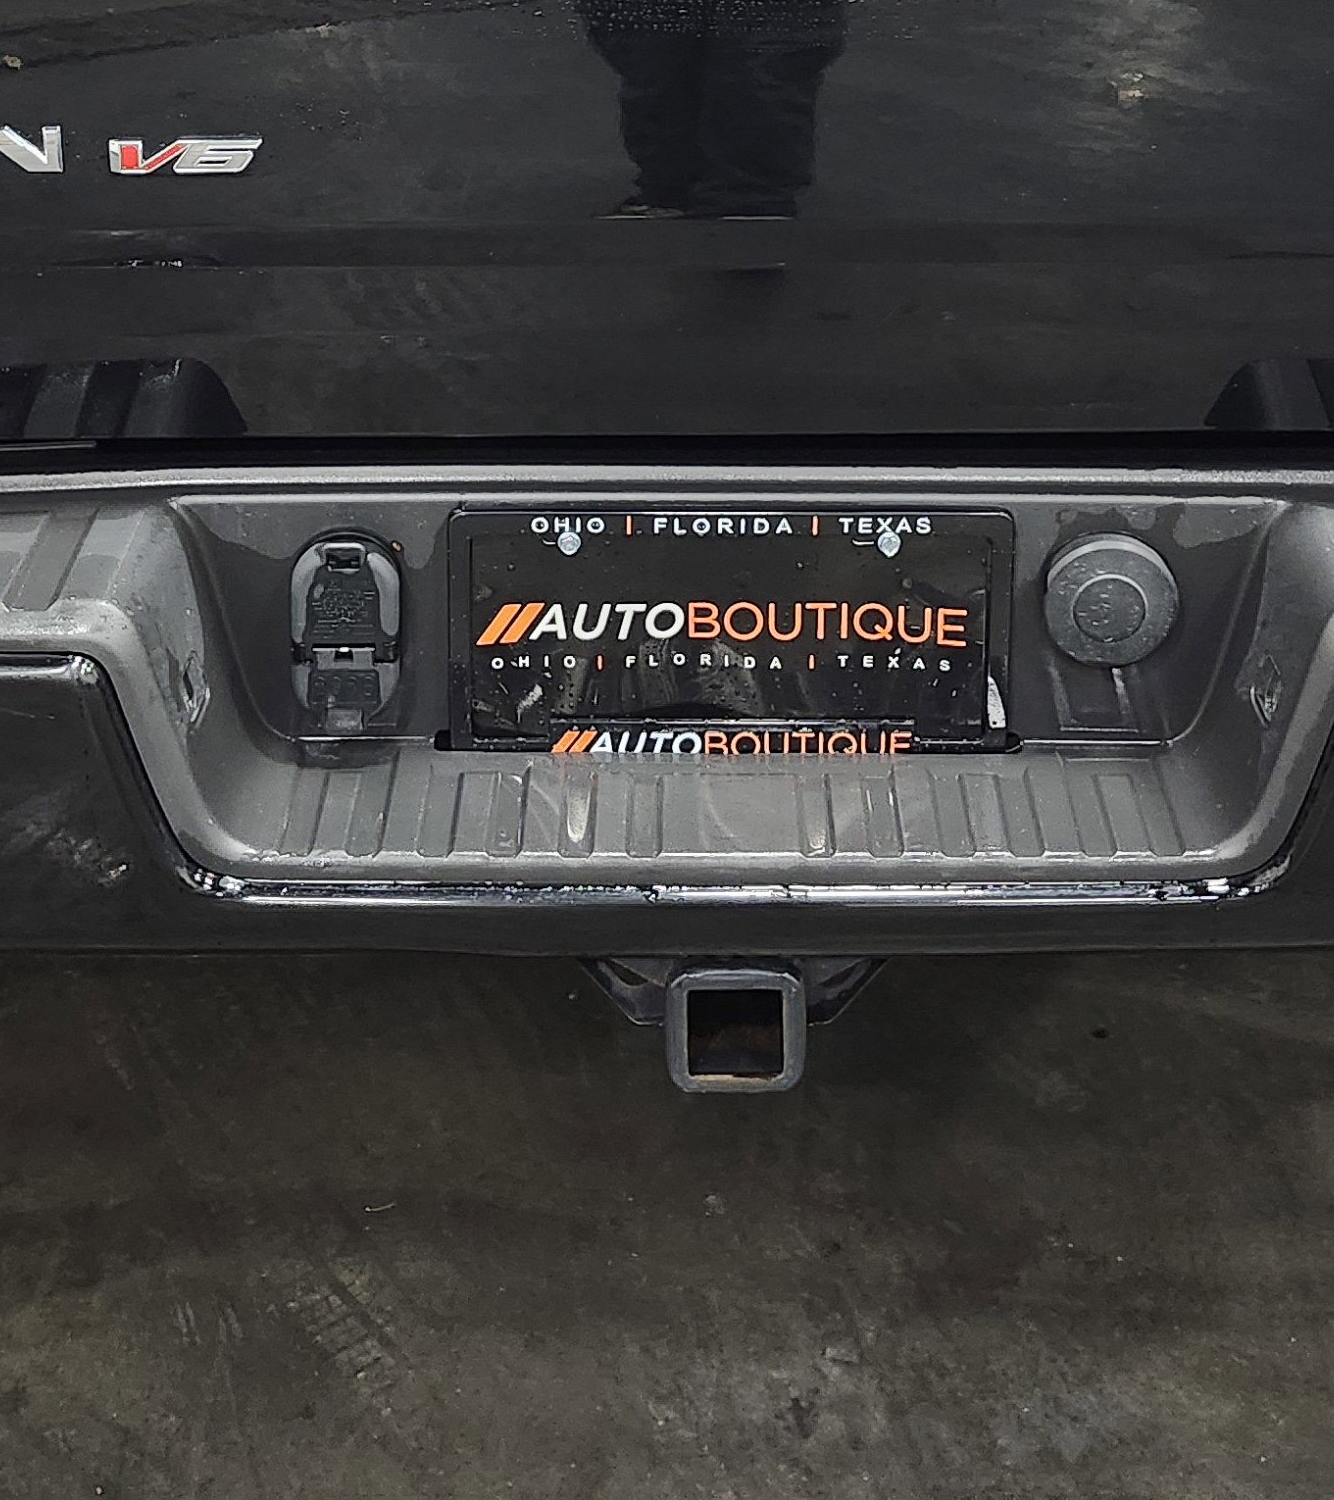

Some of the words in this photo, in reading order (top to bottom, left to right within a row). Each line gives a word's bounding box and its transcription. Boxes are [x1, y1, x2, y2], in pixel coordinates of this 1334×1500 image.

[108, 137, 264, 175] V6
[530, 517, 606, 534] OHIO
[653, 517, 793, 535] FLORIDA
[838, 517, 933, 535] TEXAS
[528, 601, 968, 648] AUTOBOUTIQUE
[490, 655, 576, 671] OHIO
[625, 653, 782, 670] FLORIDA
[837, 655, 951, 672] TEXAS
